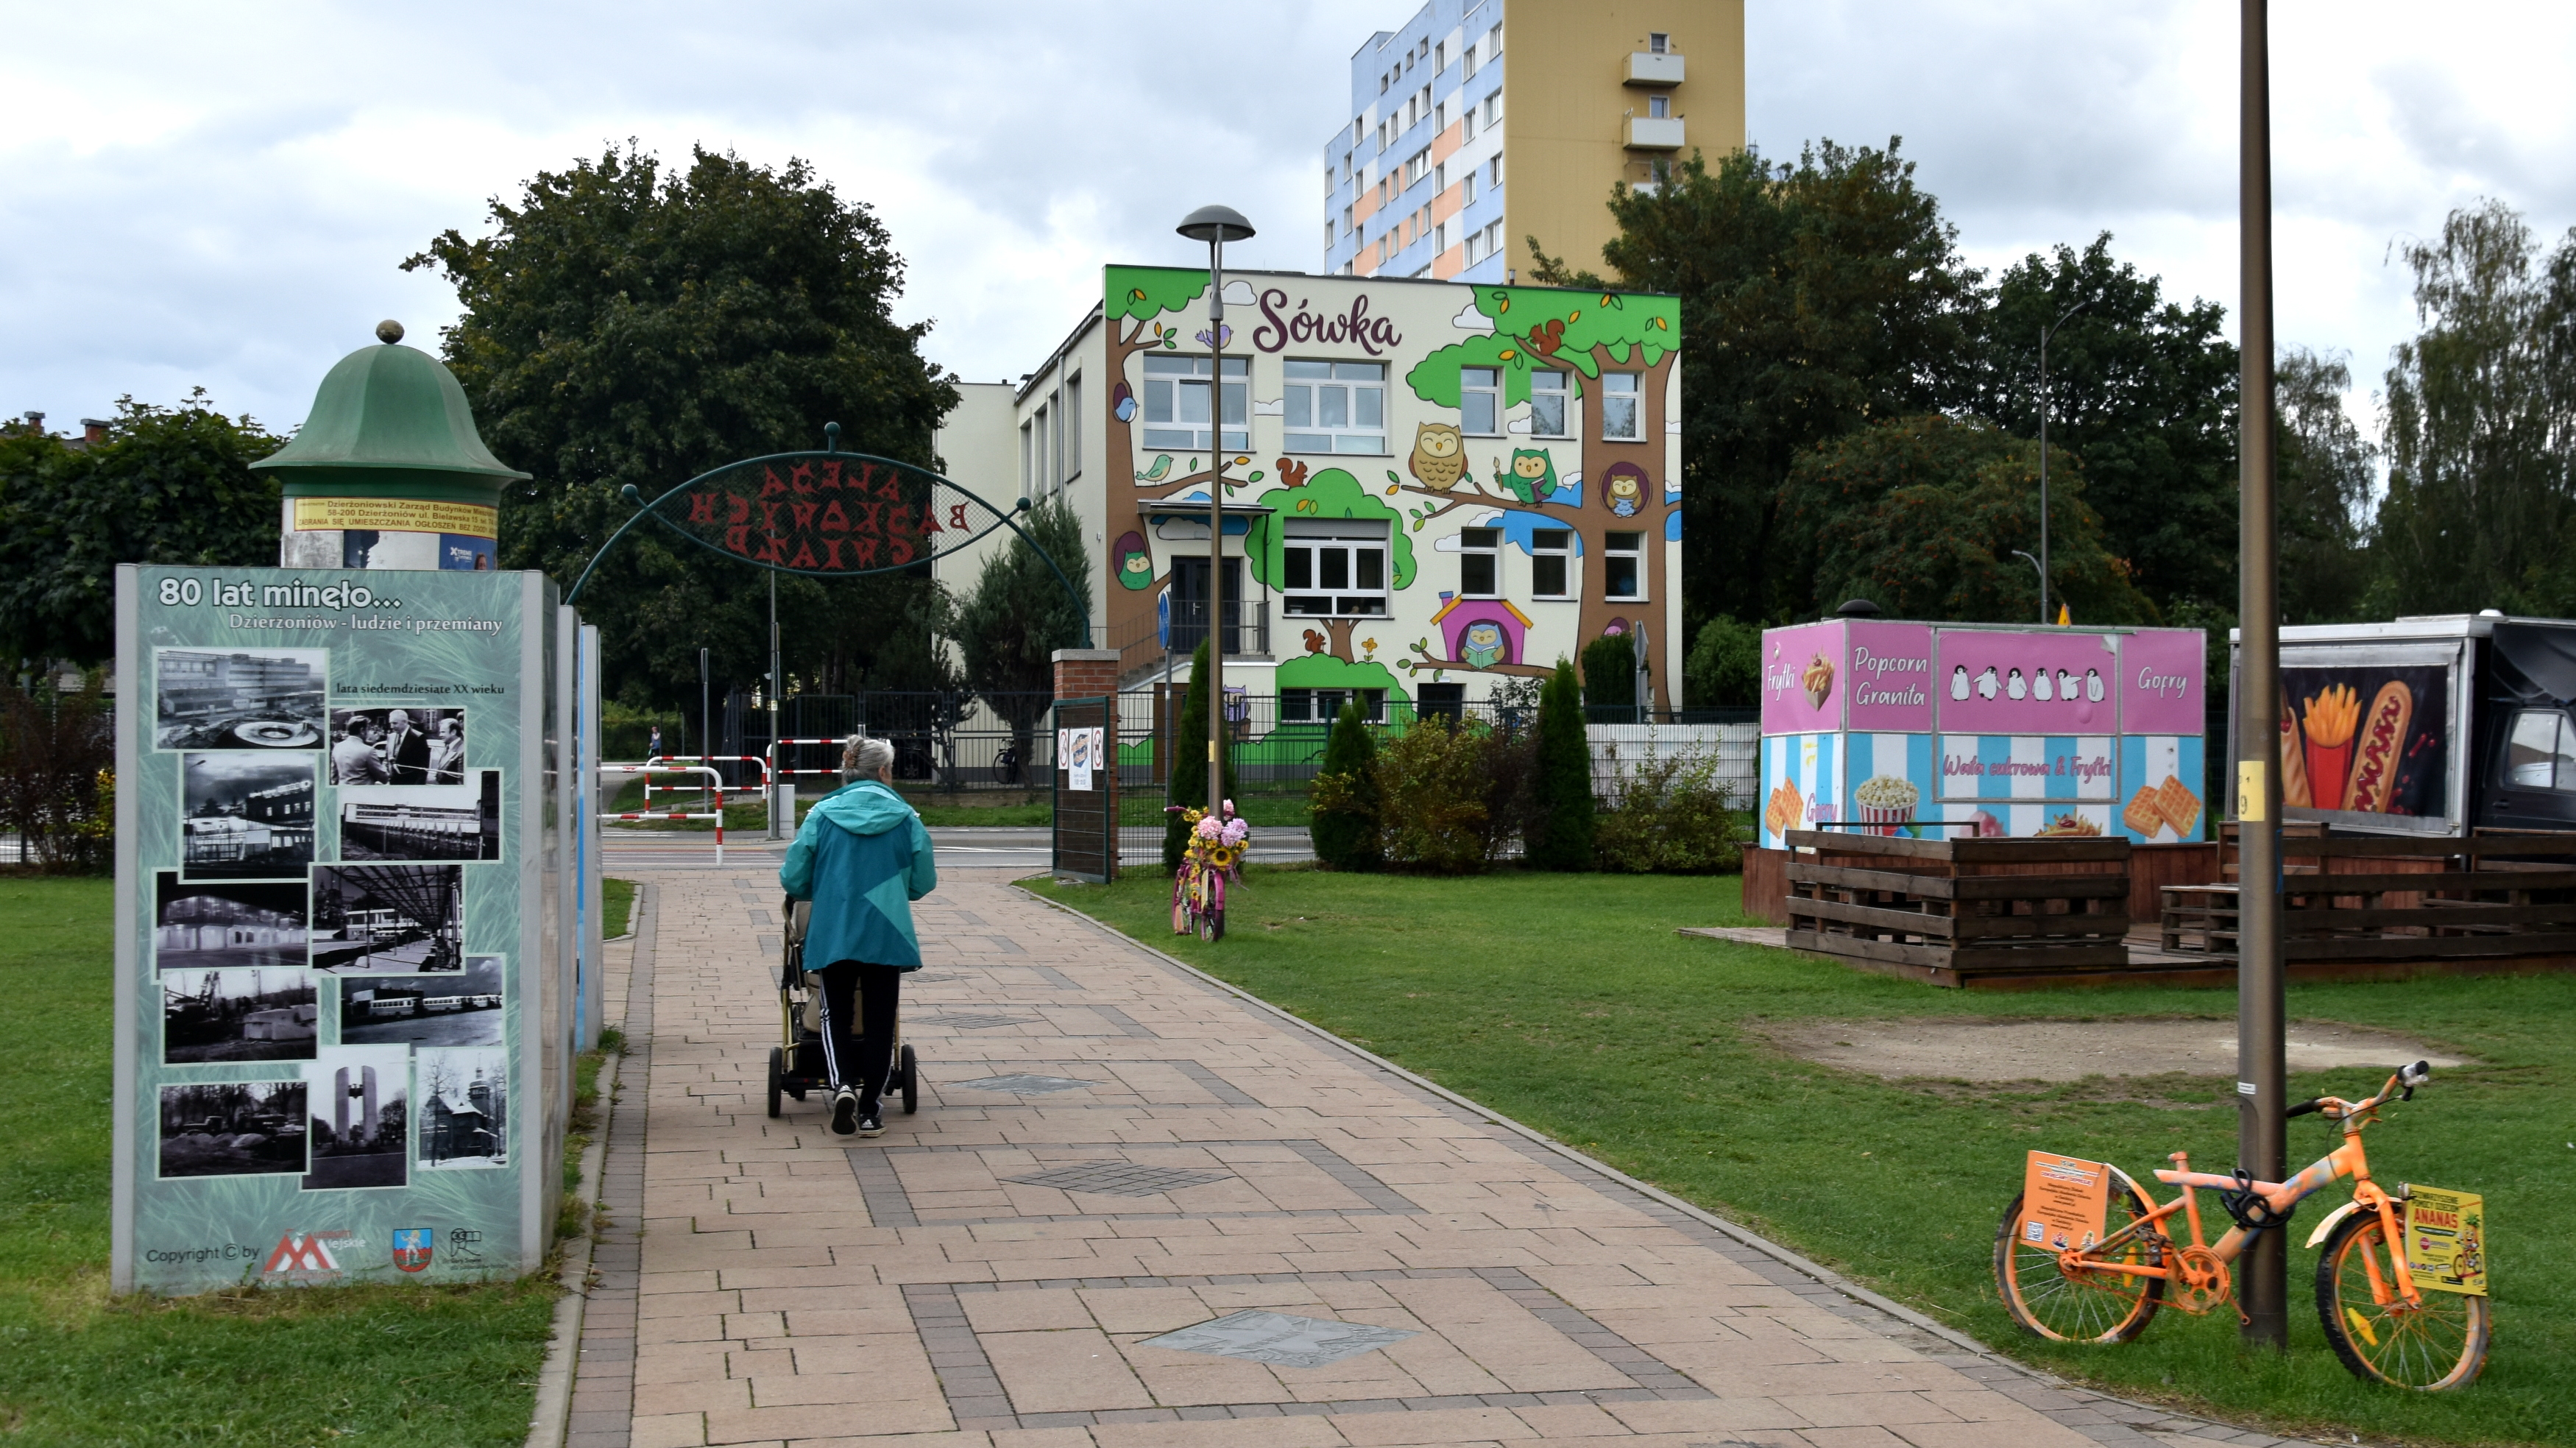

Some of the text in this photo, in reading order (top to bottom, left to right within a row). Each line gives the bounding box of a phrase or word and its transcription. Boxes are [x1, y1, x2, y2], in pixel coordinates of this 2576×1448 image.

[1253, 289, 1402, 356] Sówka
[328, 501, 396, 509] Dzierżoniowski
[399, 503, 431, 512] Zarząd
[433, 504, 471, 515] Budynków
[358, 509, 416, 518] Dzierżoniów
[432, 512, 470, 523] Bielawska
[298, 518, 329, 526] ZABRANIA
[332, 518, 344, 527] SIĘ
[348, 518, 411, 526] UMIESZCZANIA
[414, 520, 456, 529] OGŁOSZEŃ
[159, 577, 403, 611] 80 lat minęło...
[230, 614, 337, 629] Dzierżoniów
[351, 614, 403, 630] ludzie
[406, 615, 411, 630] i
[416, 616, 503, 636] przemiany
[1854, 646, 1928, 681] Popcorn
[336, 682, 358, 693] lata
[453, 685, 468, 694] XX
[471, 684, 504, 694] wieku
[1767, 663, 1796, 702] Frytki
[1855, 682, 1925, 706] Granita
[2137, 666, 2187, 699] Gofry
[1943, 755, 2112, 784] Wata cukrowa & Frytki
[2414, 1207, 2458, 1229] ANANAS
[146, 1247, 219, 1265] Copyright
[242, 1245, 260, 1262] by
